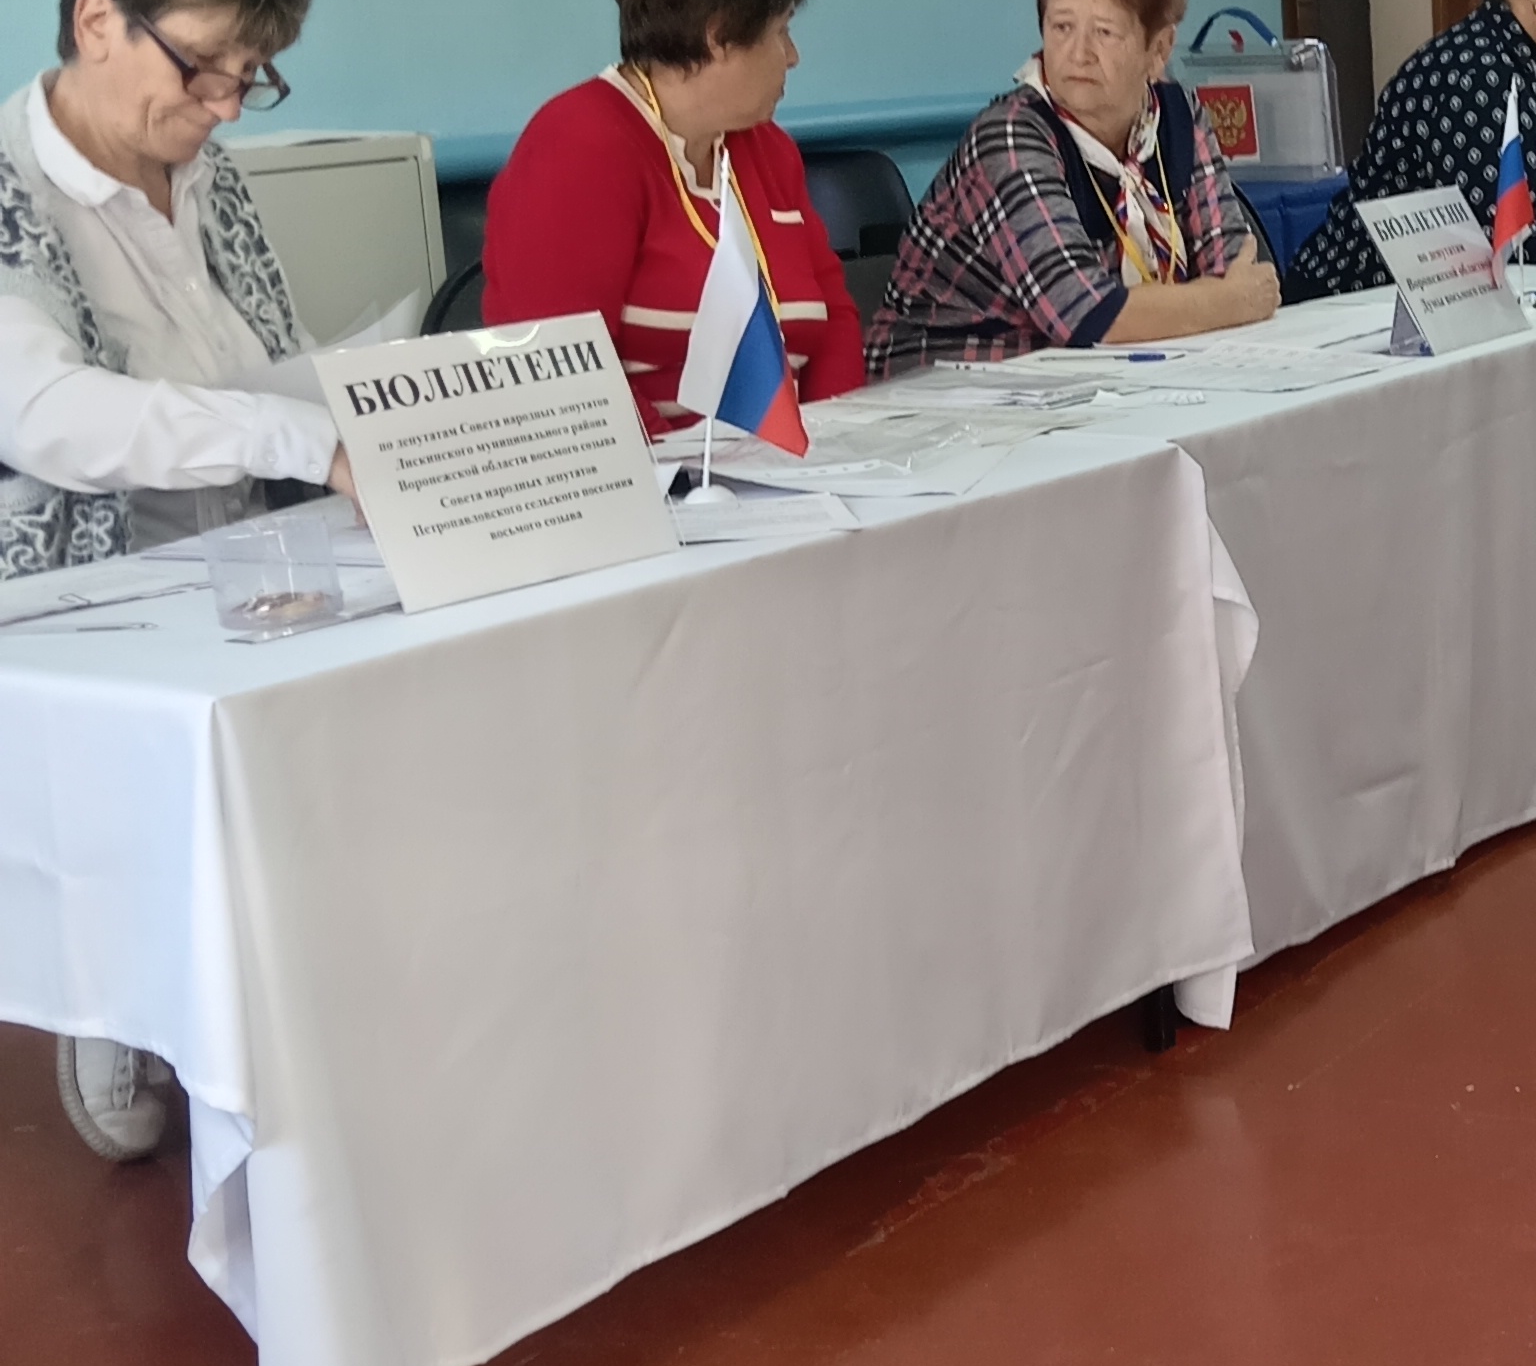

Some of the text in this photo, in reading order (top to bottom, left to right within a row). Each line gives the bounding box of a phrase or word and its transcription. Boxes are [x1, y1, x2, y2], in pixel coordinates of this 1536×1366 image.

[1373, 202, 1470, 242] БЮЛЛЕТЕНИ
[344, 340, 606, 418] БЮЛЛЕТЕНИ
[378, 397, 610, 452] по депутатам Совета народных депутатов
[396, 418, 608, 472] Лискинского муниципального района
[397, 436, 617, 492] Воронежской области восьмого созыва
[440, 465, 598, 508] Совета народных депутатов
[412, 477, 634, 537] Петропавловского сельского поселения
[489, 510, 583, 540] восьмого созыва
